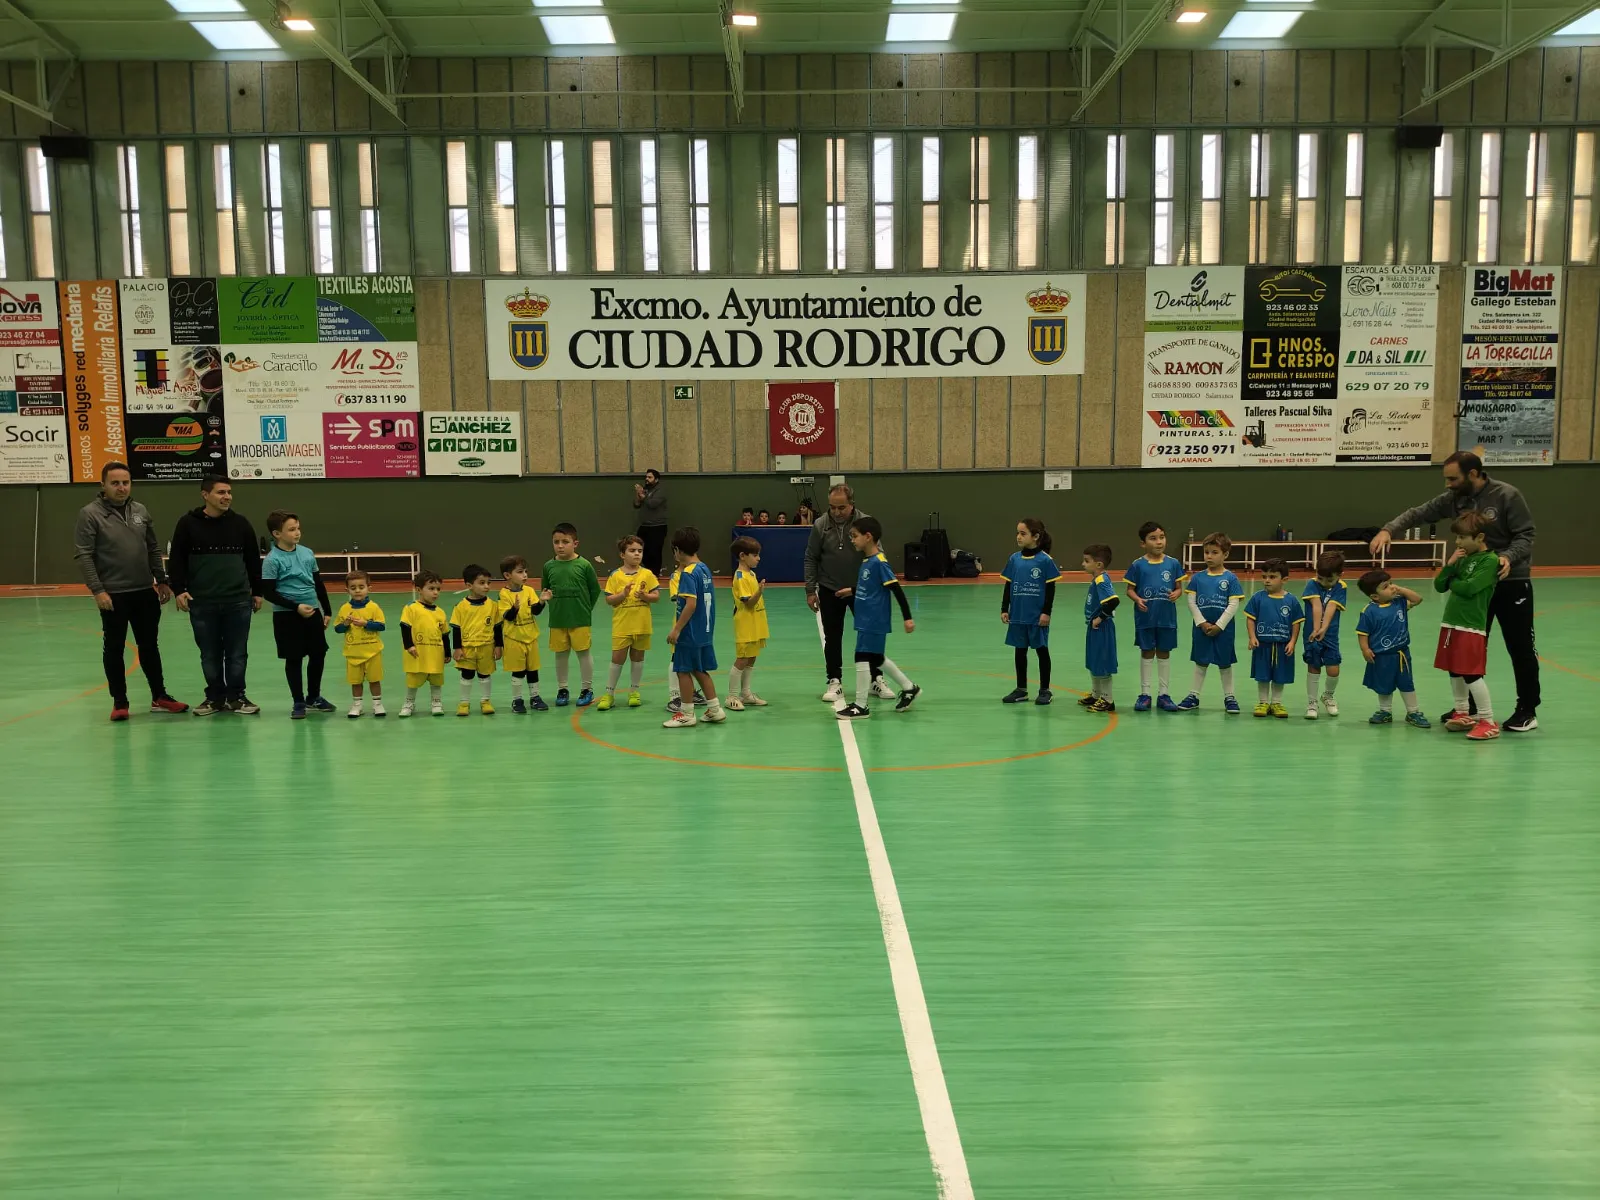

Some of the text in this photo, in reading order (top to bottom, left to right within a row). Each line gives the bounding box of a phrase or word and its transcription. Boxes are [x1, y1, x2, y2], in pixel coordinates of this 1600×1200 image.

[1274, 269, 1290, 281] AUTOS
[1345, 265, 1435, 275] ESCAYOLAS GASPAR
[317, 275, 414, 295] TEXTILES ACOSTA
[1473, 269, 1555, 297] BigMat
[238, 279, 294, 312] Cid
[1470, 297, 1556, 308] Gallego Esteban
[0, 302, 42, 313] OVA
[590, 284, 983, 326] Excmo. Ayuntamiento de
[568, 326, 1006, 369] CIUDAD RODRIGO
[1279, 337, 1326, 352] HNOS.
[1369, 336, 1409, 346] CARNES
[271, 352, 308, 360] Residencia
[1147, 338, 1240, 360] TRANSPORTE DE GANADO
[1466, 344, 1553, 361] LA TORRECILLA
[1278, 353, 1335, 368] CRESPO
[1358, 350, 1401, 364] DA & SIL
[96, 337, 119, 404] Inmobiliaria
[262, 360, 318, 372] Caracillo
[1164, 361, 1224, 375] RAMON
[1247, 371, 1288, 379] CARPINTERÍA
[1295, 371, 1335, 379] EBANISTERÍA
[1345, 381, 1429, 391] 629 07 20 79
[74, 377, 91, 431] solyges
[344, 395, 406, 404] 637 83 11 90
[778, 393, 825, 414] CLUB DEPORTIVO
[1244, 405, 1332, 417] Talleres Pascual Silva
[1467, 403, 1516, 413] MONSAGRO
[1159, 412, 1222, 426] Autolack
[1386, 411, 1421, 420] Bodega
[5, 425, 59, 442] Sacir
[101, 405, 124, 455] Asesoría
[780, 427, 794, 443] TRES
[1159, 430, 1214, 439] PINTURAS,
[1477, 435, 1497, 444] MAR
[81, 435, 94, 479] SEGUROS
[230, 444, 322, 458] MIROBRIGAWAGEN
[1157, 445, 1235, 455] 923 250 971
